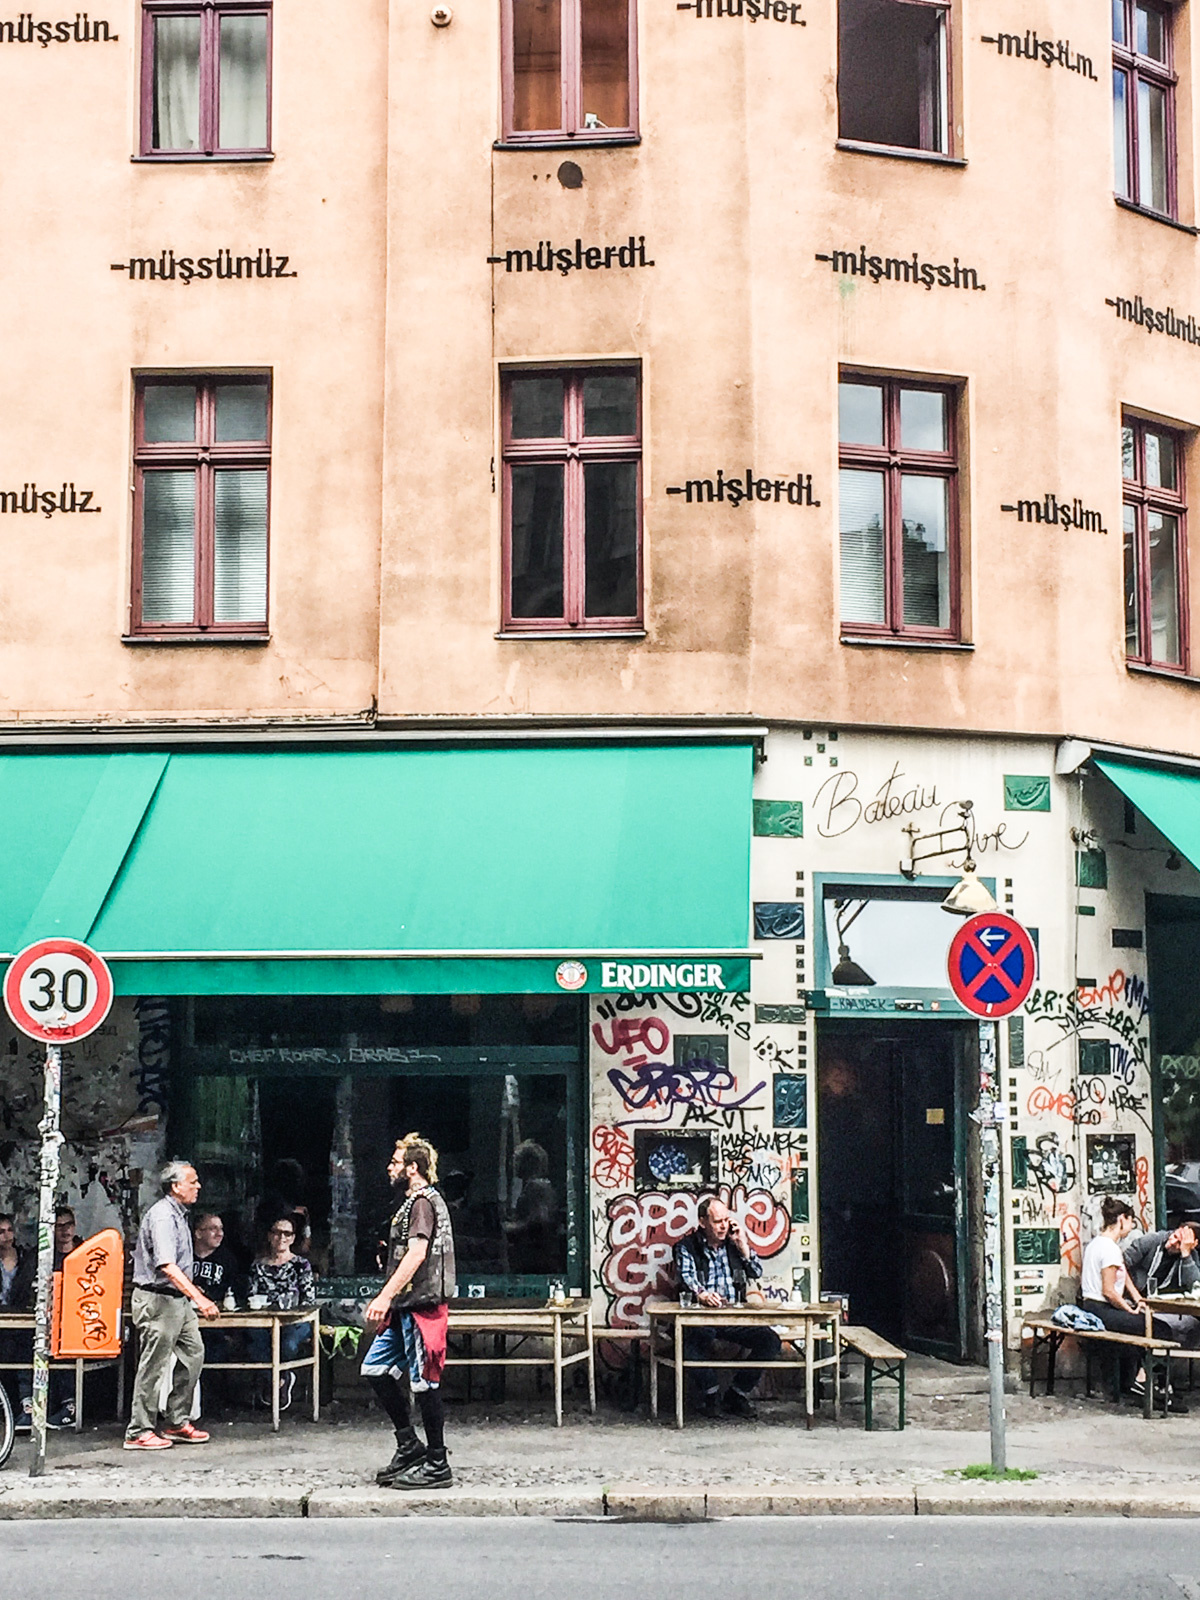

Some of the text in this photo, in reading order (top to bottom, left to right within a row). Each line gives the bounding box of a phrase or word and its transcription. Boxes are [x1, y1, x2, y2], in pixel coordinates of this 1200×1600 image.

[812, 761, 941, 838] Bateau
[28, 967, 88, 1013] 30
[601, 961, 726, 990] ERDINGER
[592, 1016, 670, 1055] UFO
[680, 1101, 765, 1132] AKUT
